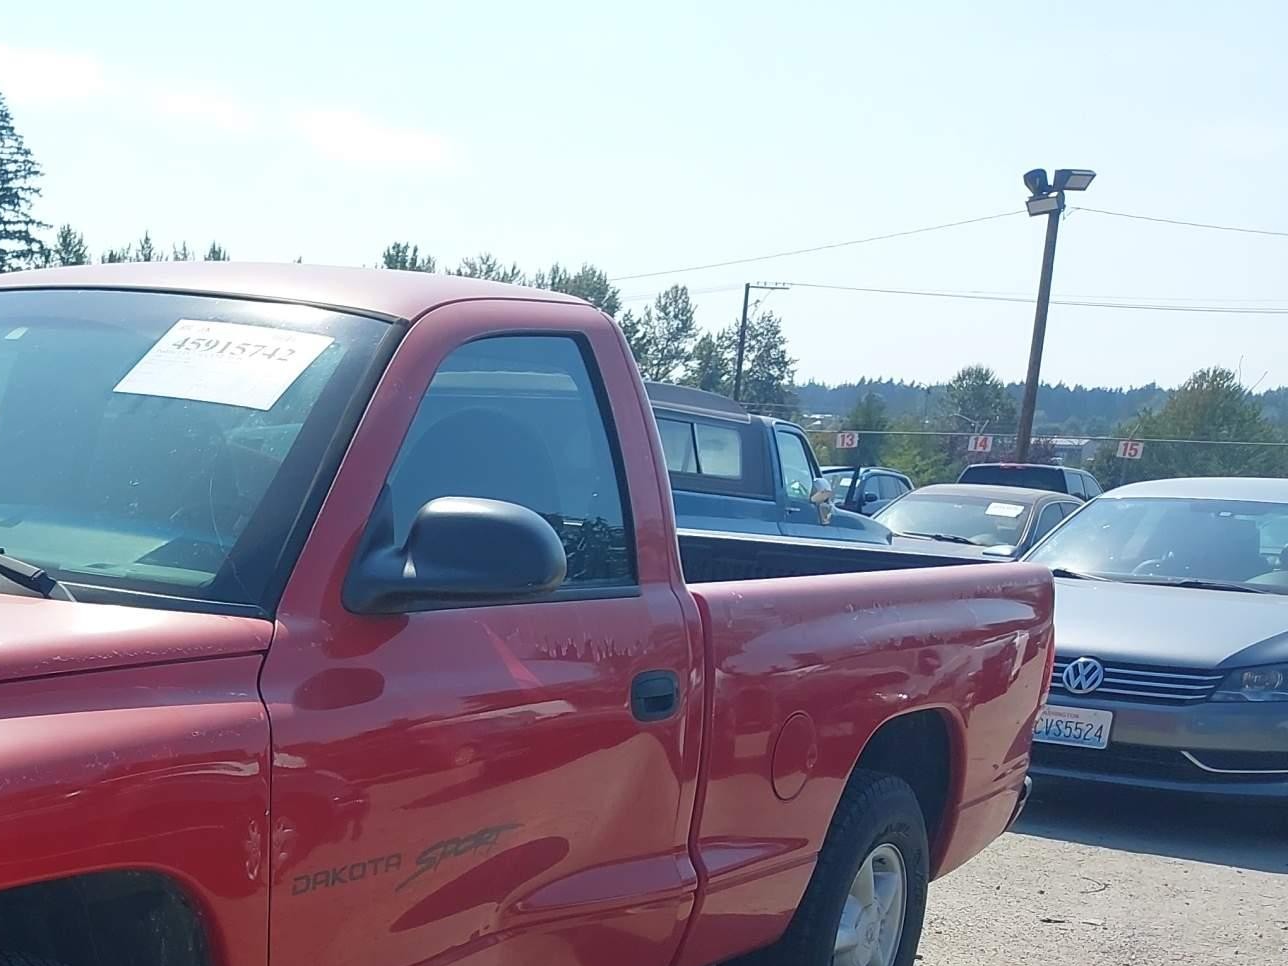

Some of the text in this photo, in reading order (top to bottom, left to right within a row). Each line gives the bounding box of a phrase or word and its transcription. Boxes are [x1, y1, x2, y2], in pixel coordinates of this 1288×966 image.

[171, 336, 297, 362] 45915742
[839, 433, 855, 448] 13
[973, 436, 988, 451] 14
[1122, 442, 1140, 458] 15
[291, 822, 525, 896] DAKOTA SPORT
